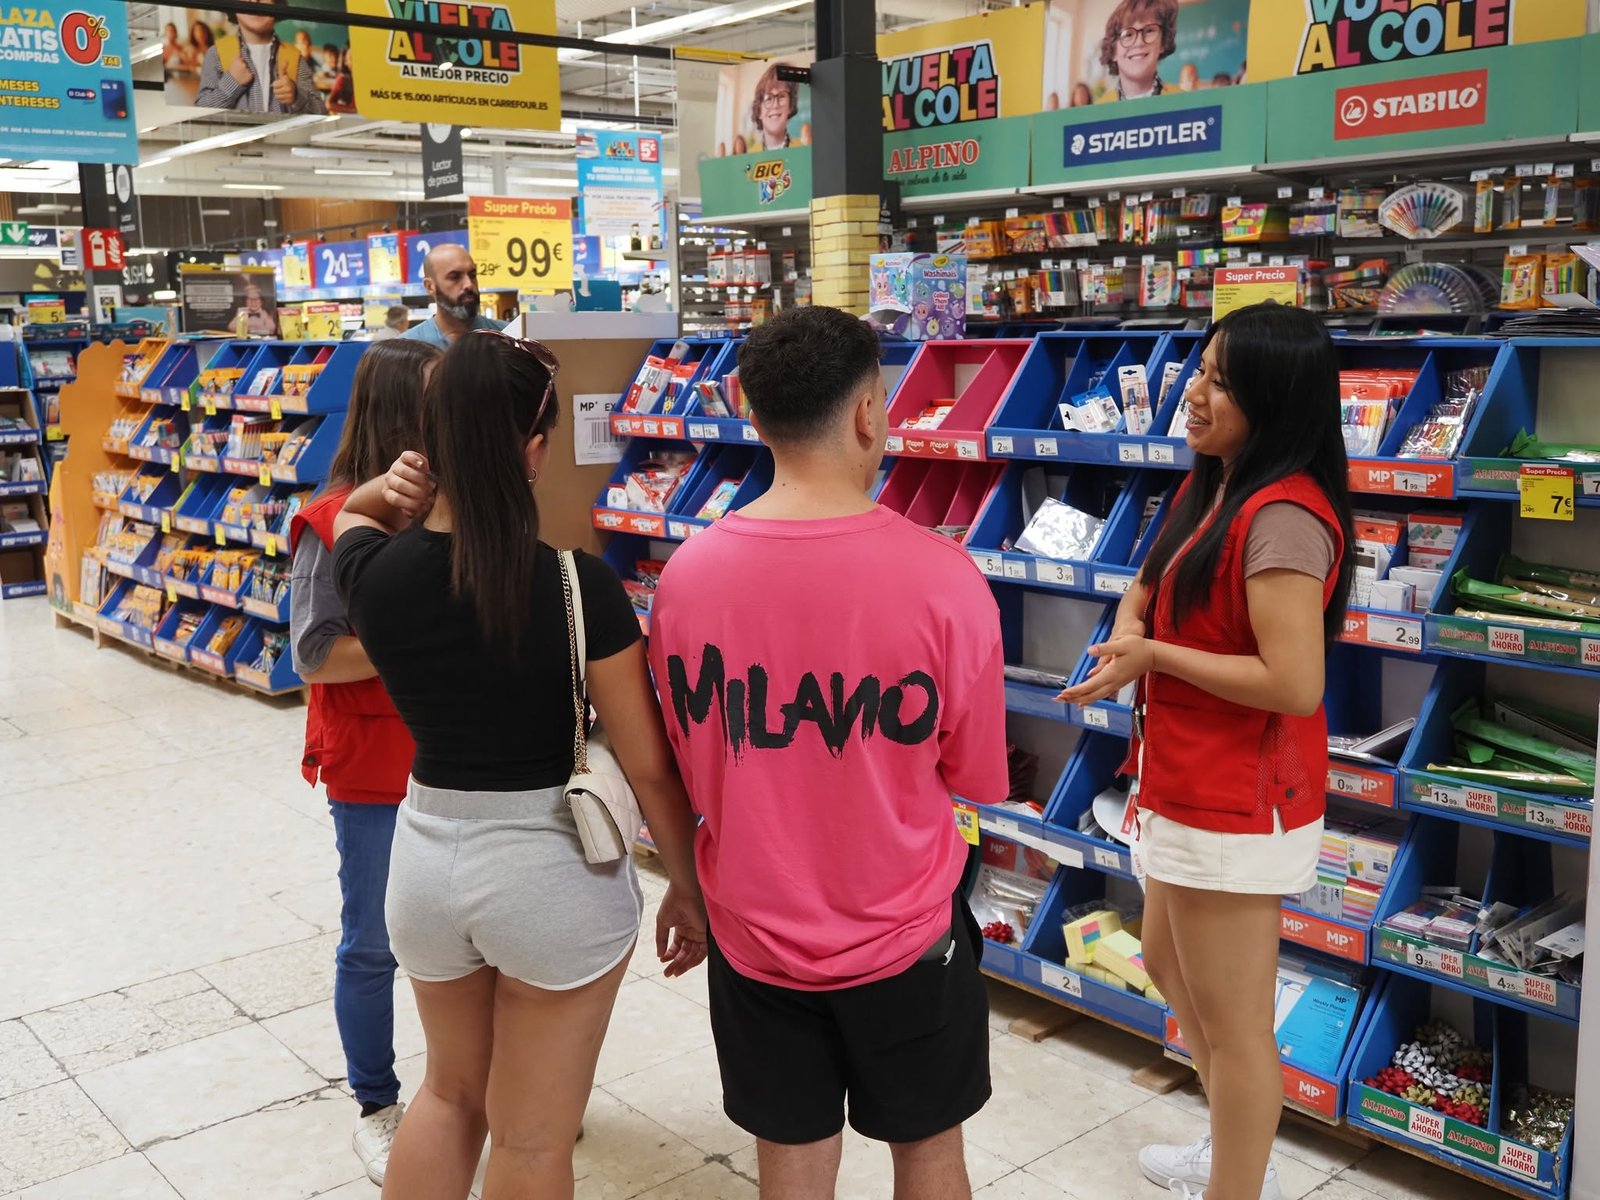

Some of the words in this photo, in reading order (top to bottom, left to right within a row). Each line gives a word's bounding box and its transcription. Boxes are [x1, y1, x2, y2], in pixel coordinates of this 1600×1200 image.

[0, 26, 58, 51] ATIS
[1298, 19, 1360, 73] AL
[1368, 0, 1505, 61] COLE
[390, 31, 432, 61] AL
[402, 65, 418, 78] AL
[421, 66, 462, 81] MEJOR
[466, 71, 509, 85] PRECIO
[882, 44, 992, 96] VUELTA
[370, 88, 389, 100] MÁS
[391, 91, 402, 100] DE
[404, 92, 432, 103] 15.000
[433, 93, 478, 106] ARTÍCULOS
[479, 97, 489, 106] EN
[490, 98, 548, 111] CARREFOUR.ES
[882, 92, 910, 131] AL
[914, 78, 996, 127] COLE
[1372, 87, 1478, 119] STABILO
[1089, 121, 1207, 154] STAEDTLER
[432, 158, 453, 171] Lector
[888, 139, 979, 174] ALPINO
[428, 176, 437, 187] de
[436, 171, 459, 188] precios
[484, 200, 519, 215] Super
[521, 201, 557, 215] Precio
[507, 236, 562, 278] 99€
[122, 265, 146, 286] SUSHI
[923, 268, 957, 278] Washimals
[1225, 271, 1254, 283] Super
[1255, 269, 1286, 280] Precio
[906, 439, 924, 449] Maped
[930, 441, 948, 450] Maped
[1368, 470, 1390, 483] MP
[1546, 468, 1567, 476] Precio
[1440, 627, 1485, 643] ALPINO
[1494, 631, 1519, 642] SUPER
[1491, 640, 1523, 652] AHORRO
[1528, 640, 1578, 655] ALPINO
[667, 642, 939, 766] MILANO
[1434, 791, 1448, 804] 13
[1467, 791, 1493, 804] SUPER
[1529, 809, 1545, 823] 13
[1563, 810, 1587, 824] UPER
[1563, 820, 1592, 834] HORRO
[1282, 916, 1304, 932] MP
[1326, 930, 1349, 947] MP
[1415, 952, 1424, 965] 9
[1441, 961, 1462, 975] ORRO
[1497, 976, 1506, 989] 4
[1524, 977, 1551, 992] SUPER
[1334, 995, 1347, 1004] MP
[1525, 987, 1555, 1003] HORRO
[1312, 998, 1329, 1008] Weekly
[1329, 1003, 1347, 1013] Planner
[1298, 1080, 1321, 1098] MP
[1361, 1098, 1407, 1122] ALPINO
[1415, 1113, 1440, 1130] SUPER
[1411, 1122, 1442, 1141] AHORRO
[1447, 1130, 1496, 1155] ALPINO
[1505, 1146, 1533, 1164] SUPER
[1501, 1155, 1536, 1175] AHORRO
